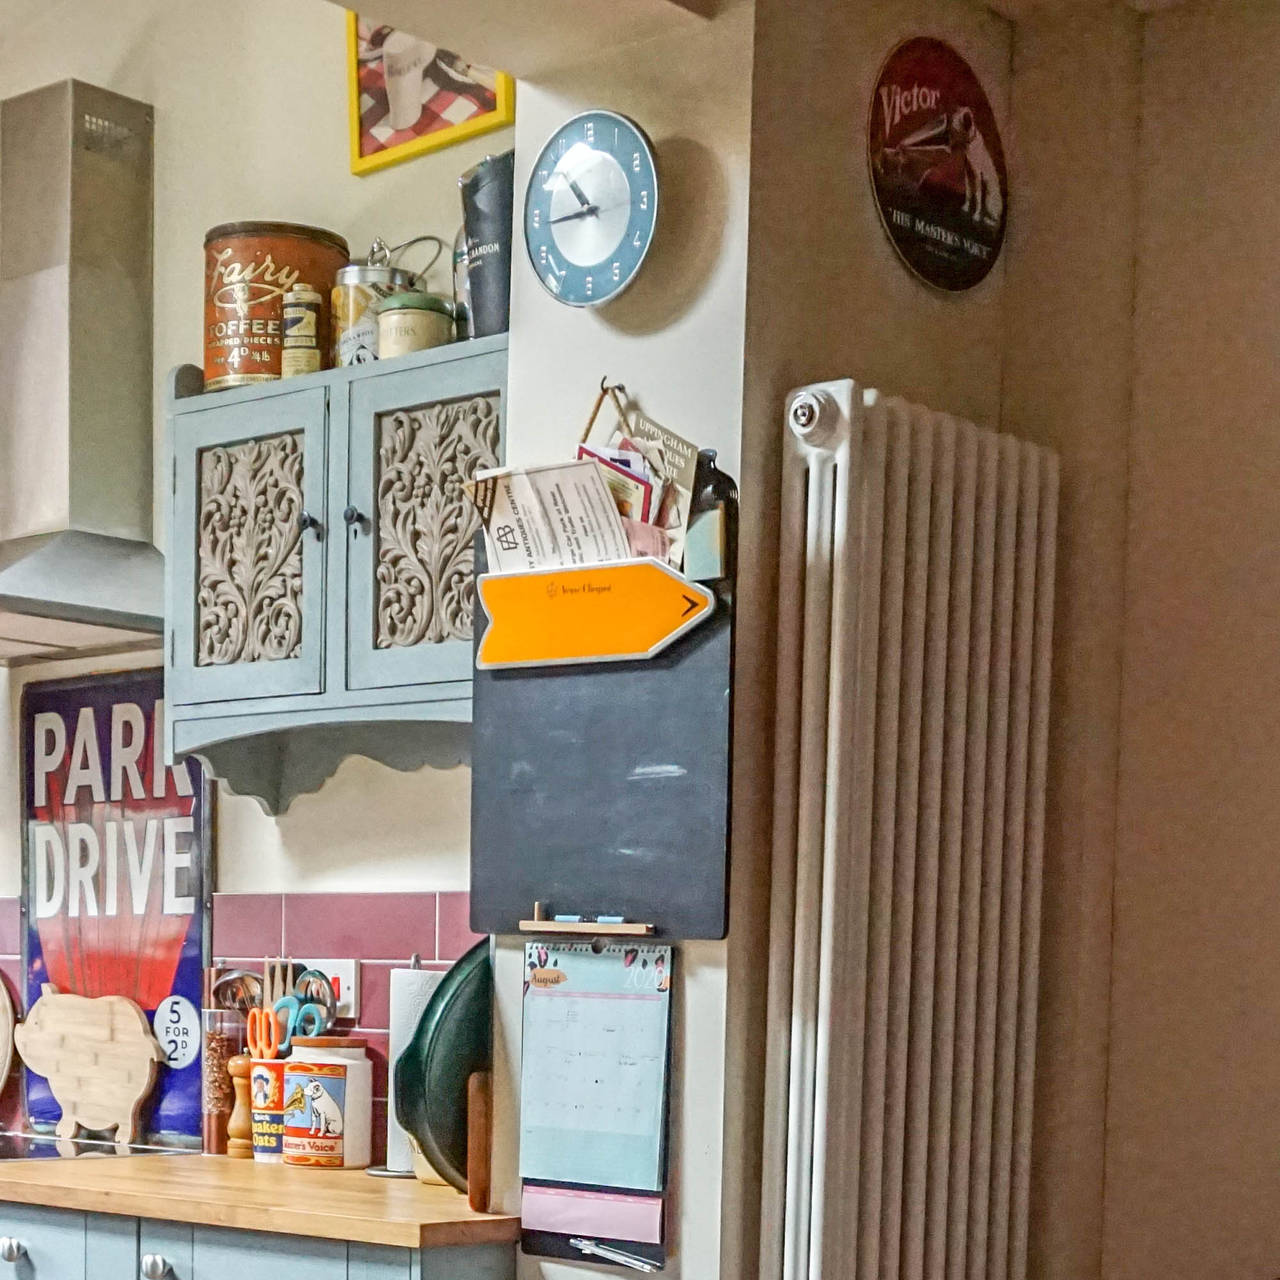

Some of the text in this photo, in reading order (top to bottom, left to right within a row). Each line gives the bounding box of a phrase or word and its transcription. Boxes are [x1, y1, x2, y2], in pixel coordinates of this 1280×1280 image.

[879, 81, 940, 139] Victor
[210, 248, 299, 297] Fairy
[208, 319, 281, 338] TOFFEE
[640, 418, 693, 458] UPPINGHAM
[35, 816, 196, 919] DRIVE
[531, 971, 560, 987] August
[169, 1001, 181, 1024] 5
[165, 1026, 189, 1037] FOR
